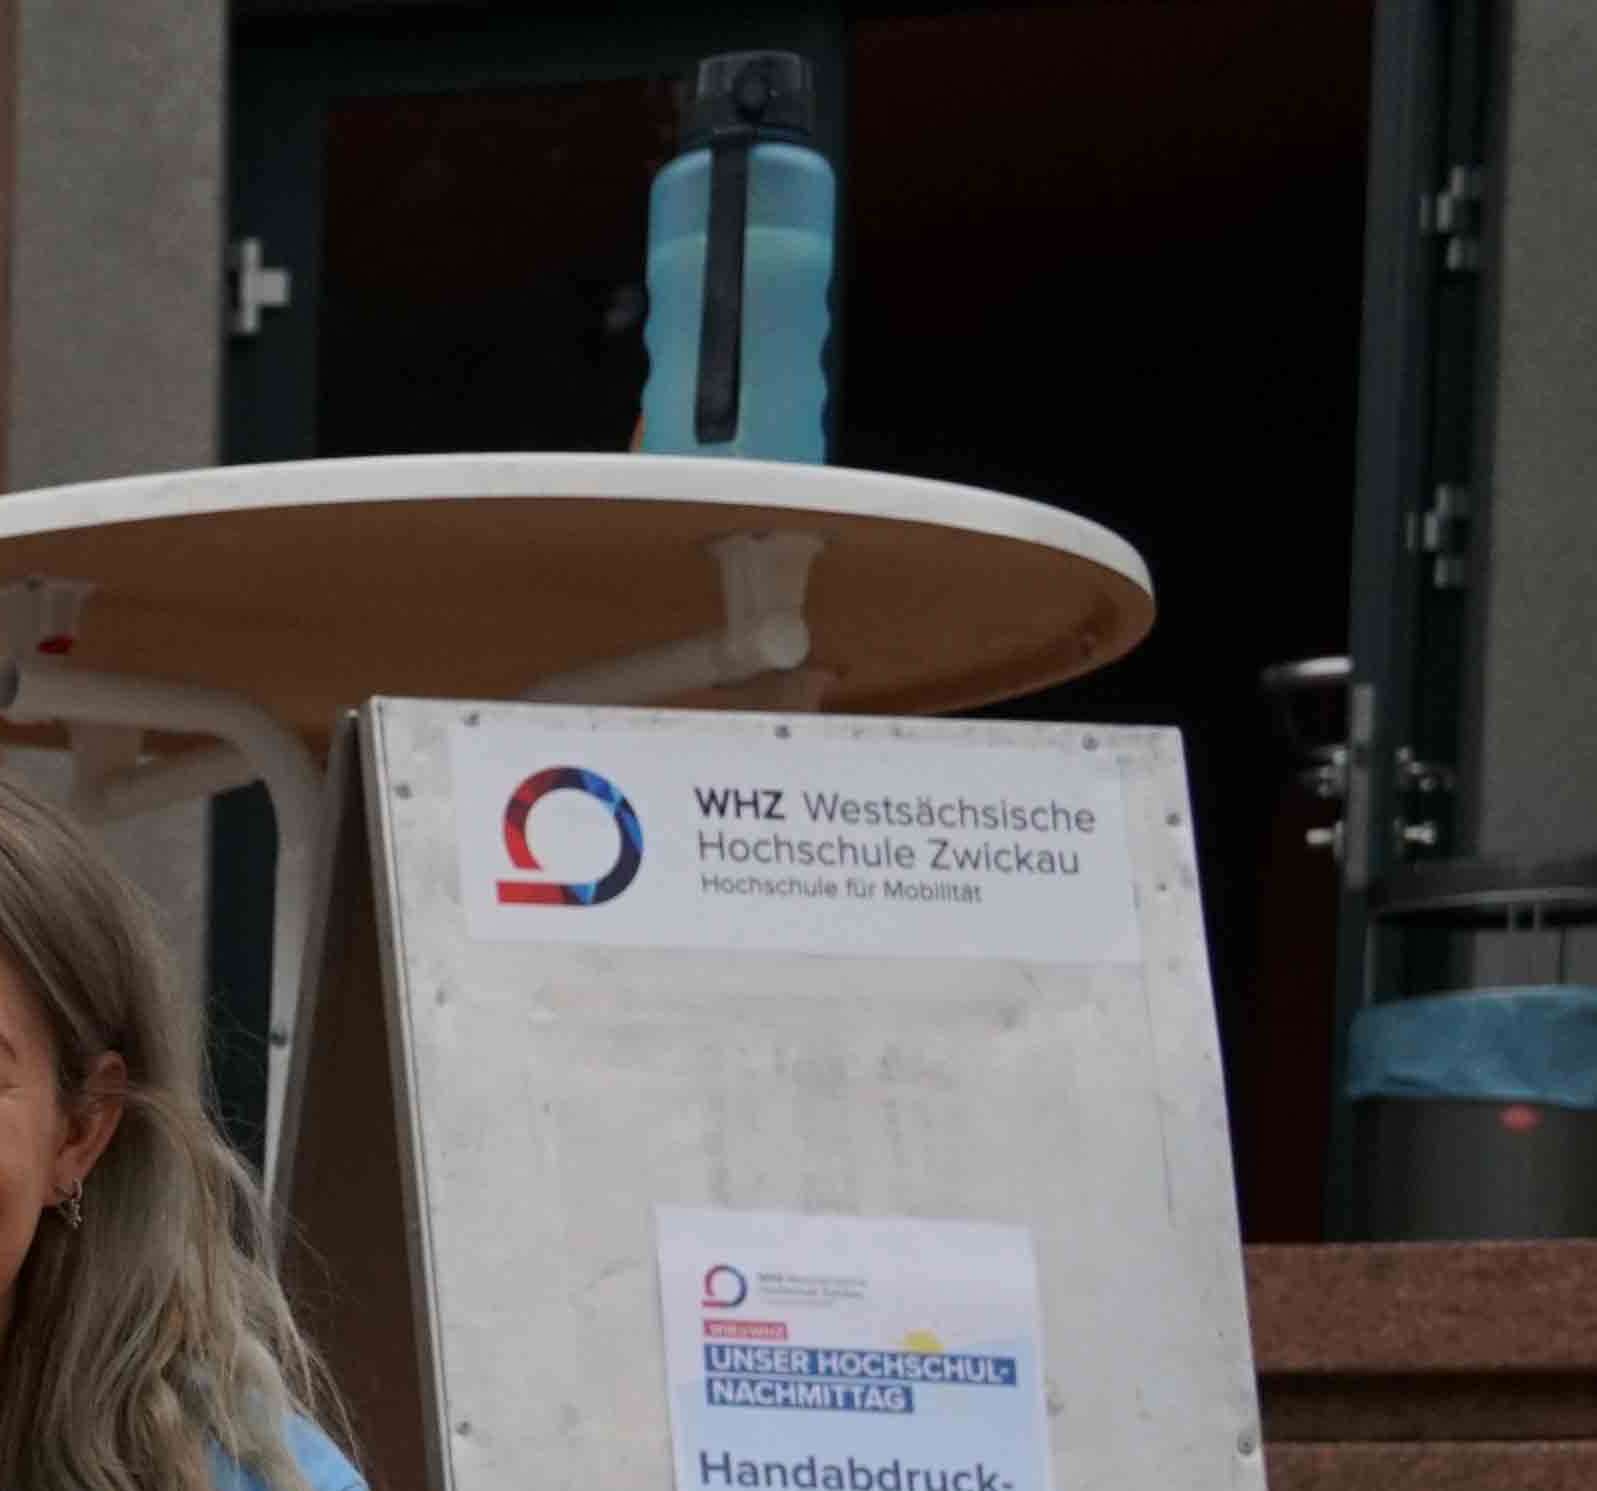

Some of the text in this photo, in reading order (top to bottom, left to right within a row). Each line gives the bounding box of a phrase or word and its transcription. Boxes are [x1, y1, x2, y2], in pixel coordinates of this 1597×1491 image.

[694, 786, 1096, 833] WHZ Westsächsische
[698, 829, 1080, 875] Hochschule Zwickau
[700, 874, 983, 903] Hochschule für Mobilität
[711, 1346, 1010, 1384] UNSER HOCHSCHUL-
[712, 1380, 906, 1411] NACHMITTAG
